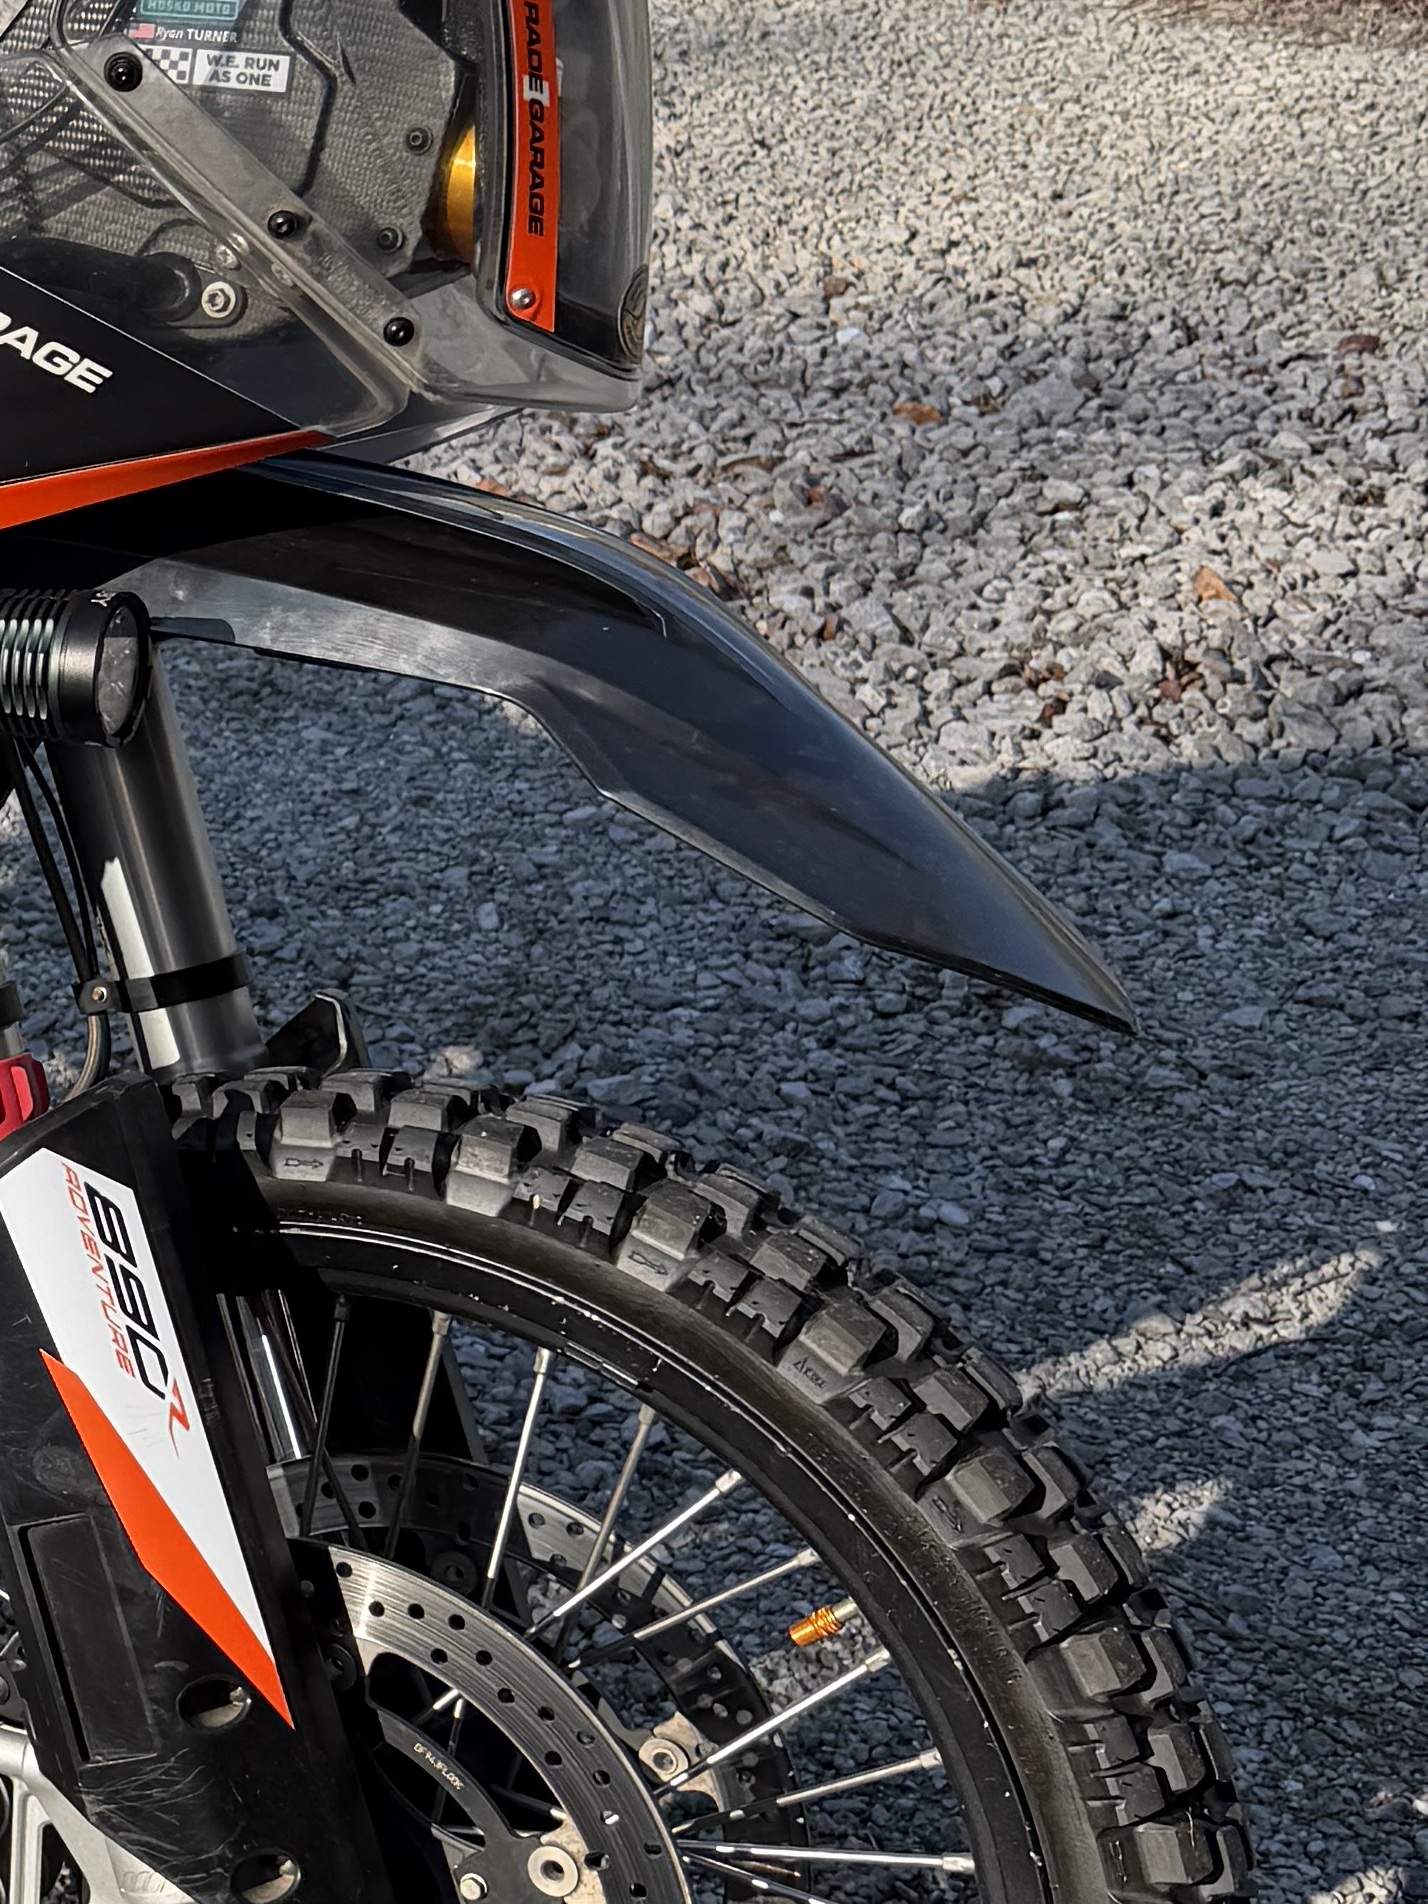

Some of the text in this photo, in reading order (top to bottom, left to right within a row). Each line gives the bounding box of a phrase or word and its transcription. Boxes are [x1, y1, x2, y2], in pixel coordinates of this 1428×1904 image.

[194, 2, 231, 16] MOTO
[156, 26, 238, 43] Ryan TURNER
[245, 56, 280, 72] RUN
[208, 70, 272, 87] AS ONE
[523, 0, 546, 238] RADE GARAGE
[61, 1162, 137, 1380] ADVENTURE
[84, 1181, 169, 1400] 890
